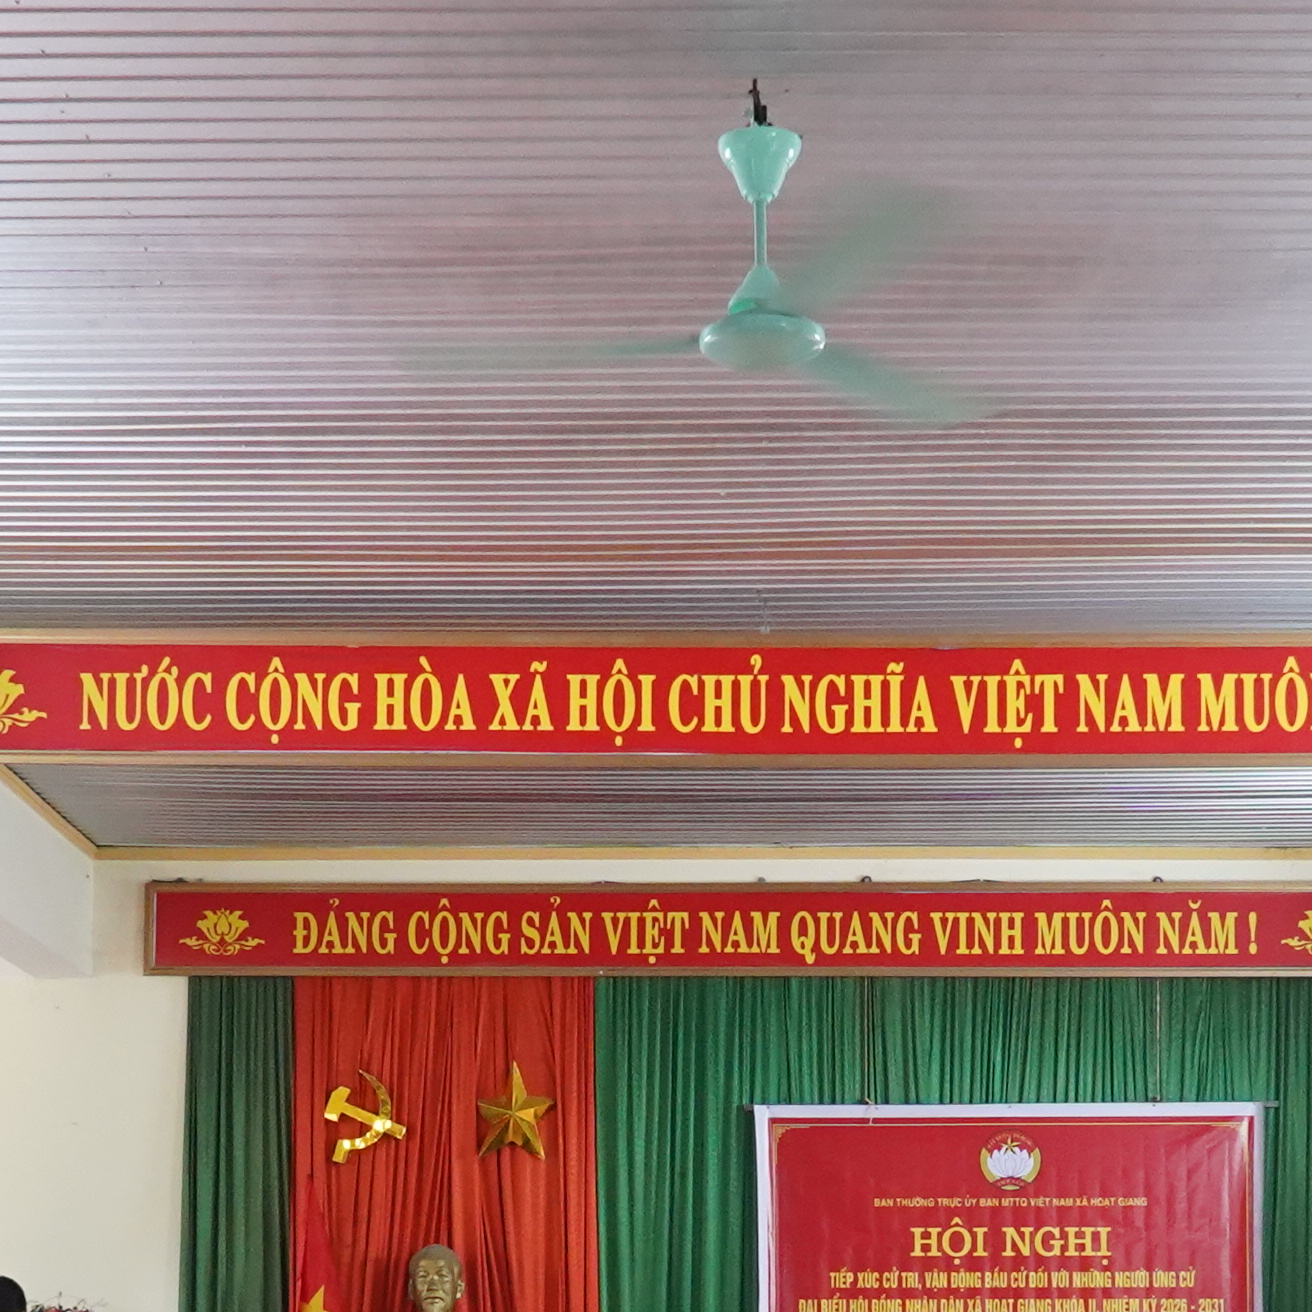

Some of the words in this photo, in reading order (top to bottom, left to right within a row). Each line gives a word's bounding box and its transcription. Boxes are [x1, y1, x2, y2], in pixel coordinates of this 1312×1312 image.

[79, 655, 214, 732] NƯỚC
[225, 656, 361, 745] CỘNG
[374, 655, 477, 732] HÒA
[489, 662, 557, 732] XÃ
[566, 658, 656, 747] HỘI
[668, 655, 770, 733] CHỦ
[782, 662, 936, 734] NGHĨA
[951, 658, 1065, 750] VIỆT
[1076, 671, 1186, 734] NAM
[293, 898, 395, 955] ĐẢNG
[407, 898, 510, 965] CỘNG
[520, 896, 593, 955] SẢN
[601, 898, 690, 964] VIỆT
[698, 911, 779, 955] NAM
[790, 911, 921, 965] QUANG
[930, 911, 1025, 955] VINH
[1035, 900, 1147, 955] MUÔN
[1156, 900, 1240, 955] NĂM
[1248, 911, 1258, 955] !
[874, 1198, 894, 1207] BAN
[937, 1197, 962, 1209] TRỰC
[979, 1198, 1000, 1207] BAN
[1001, 1197, 1028, 1207] MTTQ
[1030, 1196, 1051, 1207] VIỆT
[1053, 1197, 1073, 1207] NAM
[1075, 1195, 1088, 1207] XÃ
[1090, 1197, 1115, 1209] HOẠT
[1117, 1197, 1148, 1207] GIANG
[909, 1216, 989, 1265] HỘI
[1001, 1226, 1112, 1266] NGHỊ
[829, 1266, 854, 1289] TIẾP
[857, 1269, 880, 1289] XÚC
[882, 1266, 899, 1289] CỬ
[901, 1271, 922, 1290] TRI,
[924, 1268, 948, 1292] VẬN
[950, 1268, 982, 1292] ĐỘNG
[1010, 1265, 1028, 1288] CỬ
[1029, 1265, 1048, 1288] ĐỐI
[1050, 1267, 1070, 1288] VỚI
[1072, 1268, 1112, 1288] NHỮNG
[1115, 1267, 1149, 1288] NGƯỜI
[1152, 1267, 1177, 1288] ỨNG
[1179, 1265, 1196, 1288] CỬ
